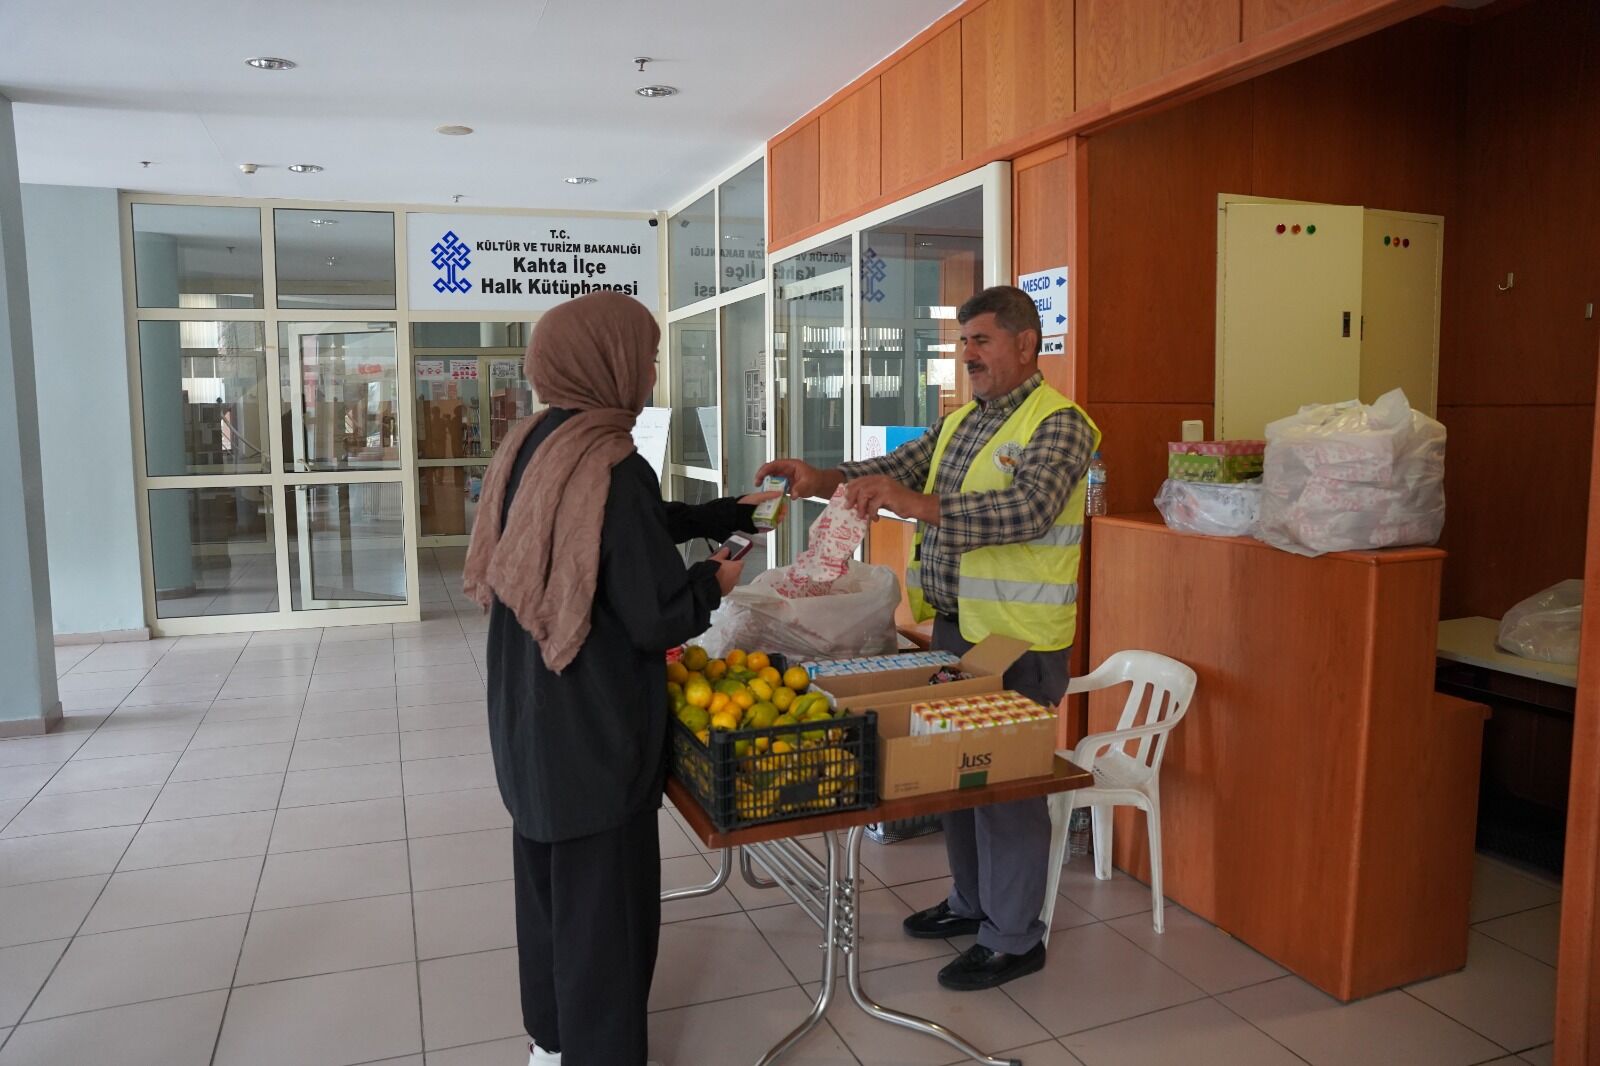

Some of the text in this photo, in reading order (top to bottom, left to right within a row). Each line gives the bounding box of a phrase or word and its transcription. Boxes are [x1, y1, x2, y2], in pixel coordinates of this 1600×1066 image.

[550, 229, 570, 239] T.C.
[476, 240, 641, 255] KÜLTÜR VE TURİZM BAKANLIĞI
[514, 254, 606, 277] Kahta İlçe
[481, 278, 638, 298] Halk Kütüphanesi
[1044, 342, 1053, 352] WC
[957, 752, 991, 769] Juss
